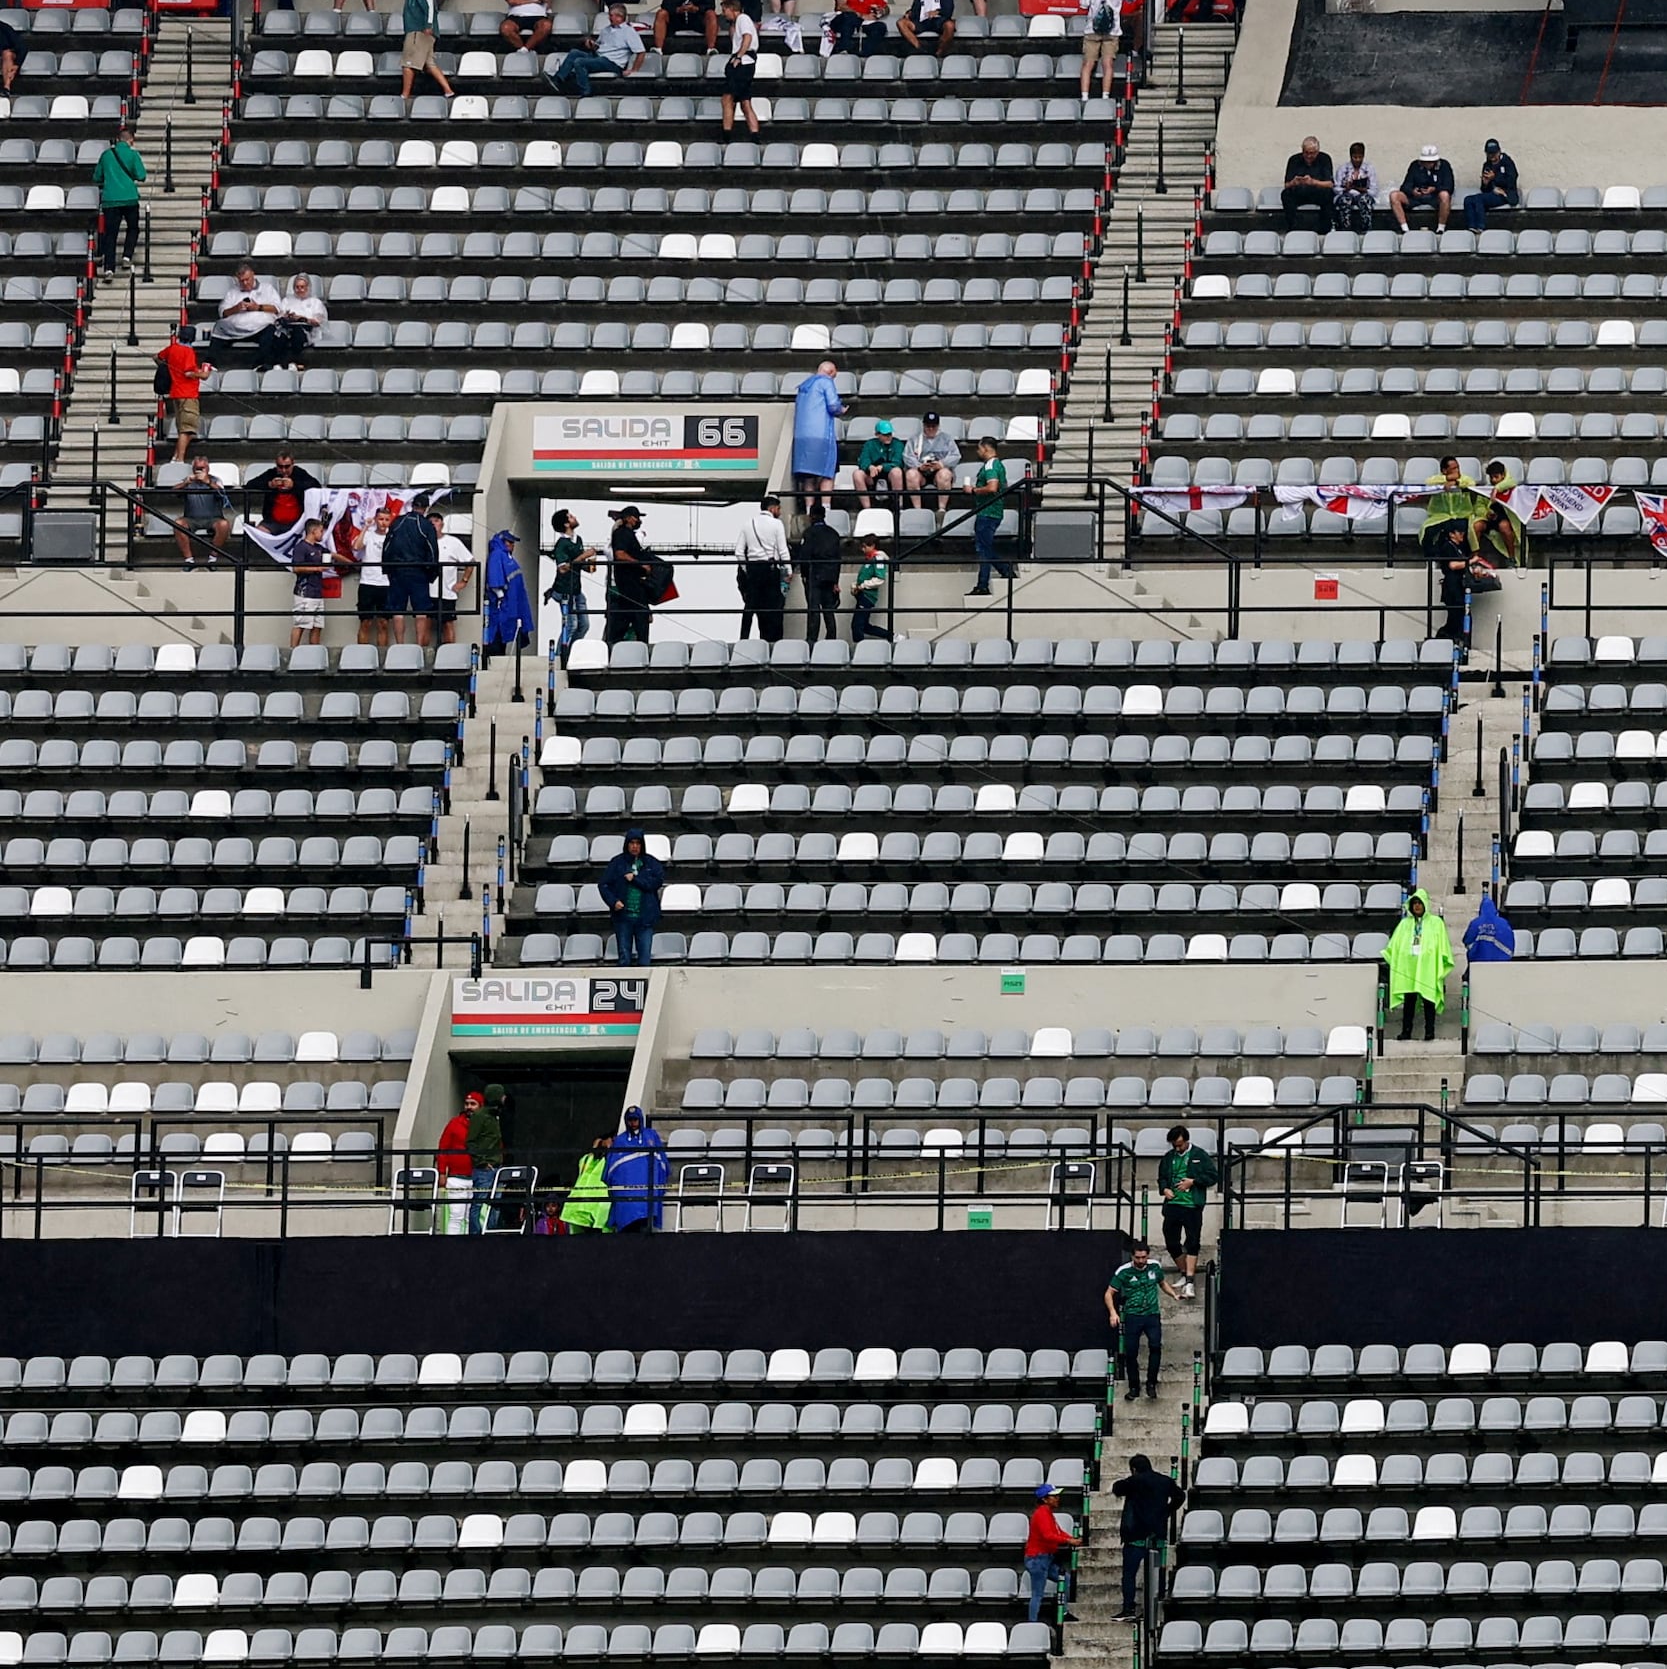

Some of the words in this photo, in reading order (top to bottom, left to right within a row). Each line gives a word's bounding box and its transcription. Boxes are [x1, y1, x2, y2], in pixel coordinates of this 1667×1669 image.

[562, 418, 671, 439] SALIDA
[697, 417, 747, 447] 66
[641, 440, 671, 448] EXIT
[591, 460, 617, 470] SALIDA
[461, 980, 576, 1002] SALIDA
[592, 980, 644, 1011] 24
[545, 1003, 576, 1011] EXIT
[492, 1026, 518, 1035] SALIDA
